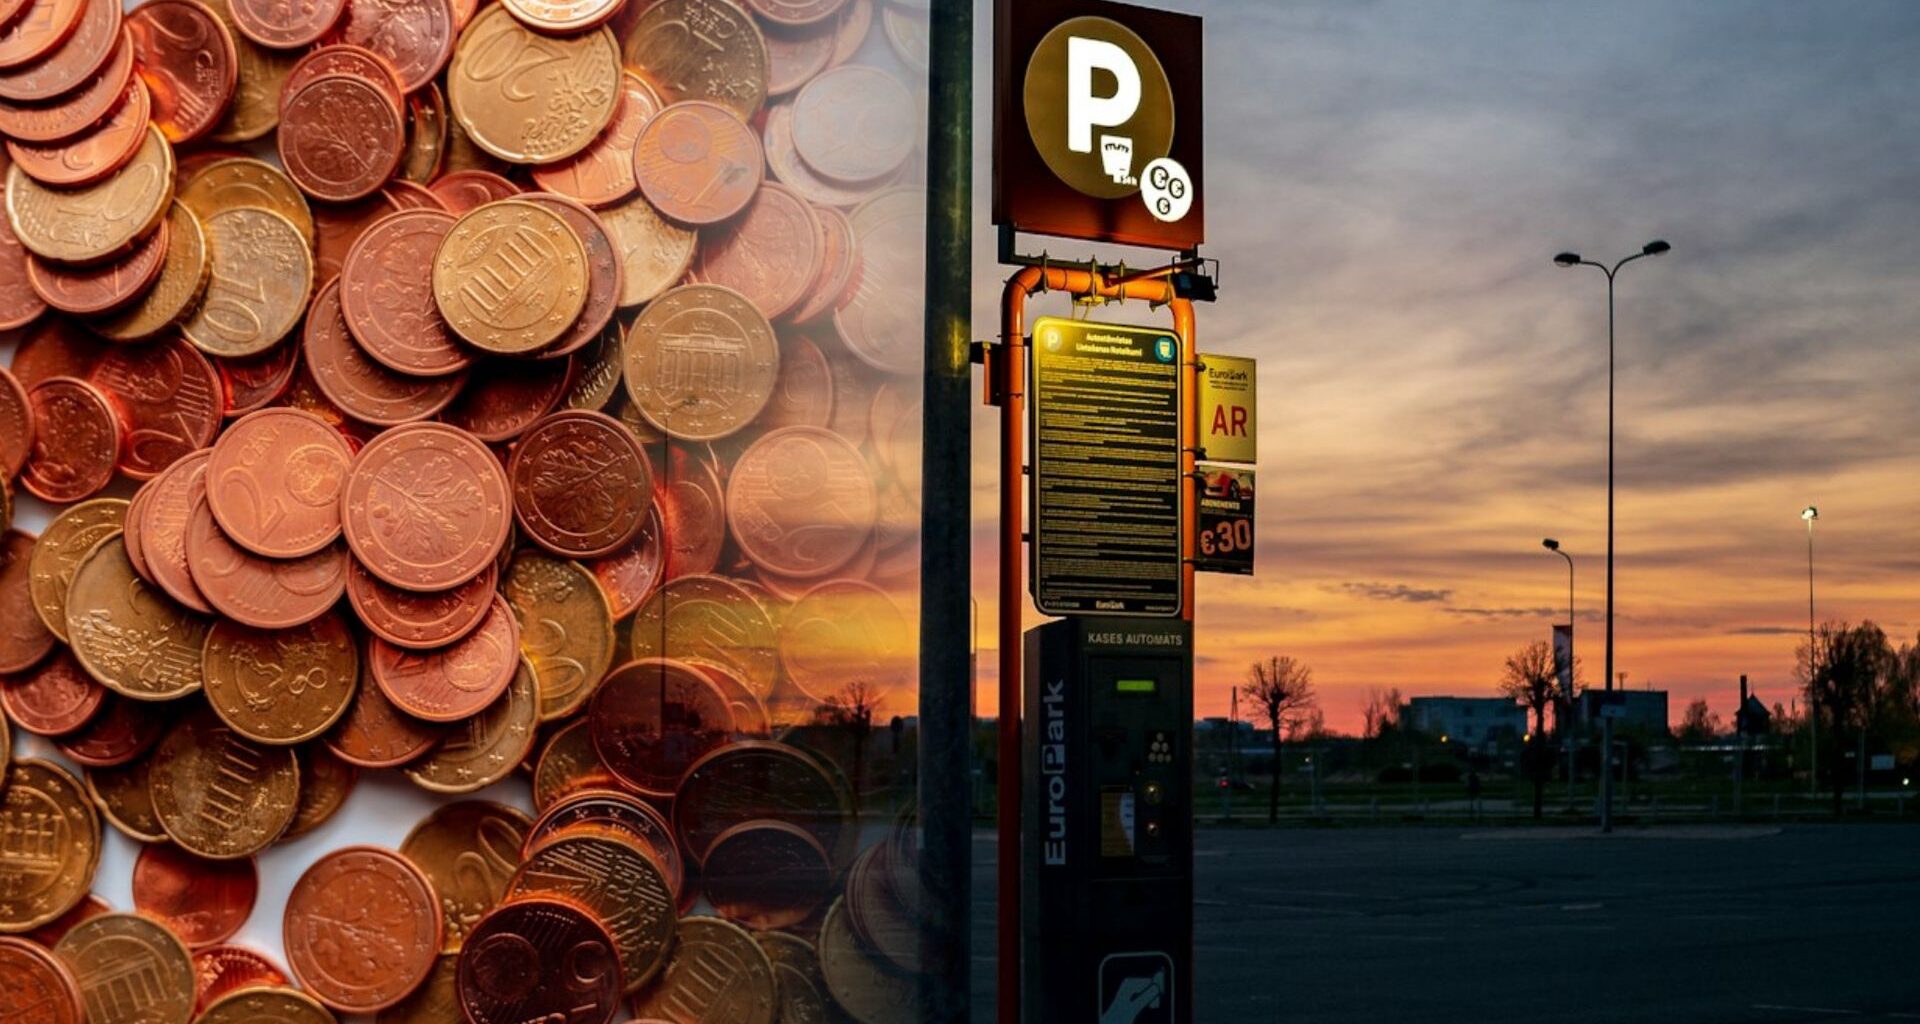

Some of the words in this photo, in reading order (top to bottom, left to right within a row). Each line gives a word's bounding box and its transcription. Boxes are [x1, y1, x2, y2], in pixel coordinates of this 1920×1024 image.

[1068, 36, 1141, 153] P
[1211, 404, 1248, 438] AR
[1088, 632, 1124, 645] KASES
[1042, 679, 1067, 866] EuroPark
